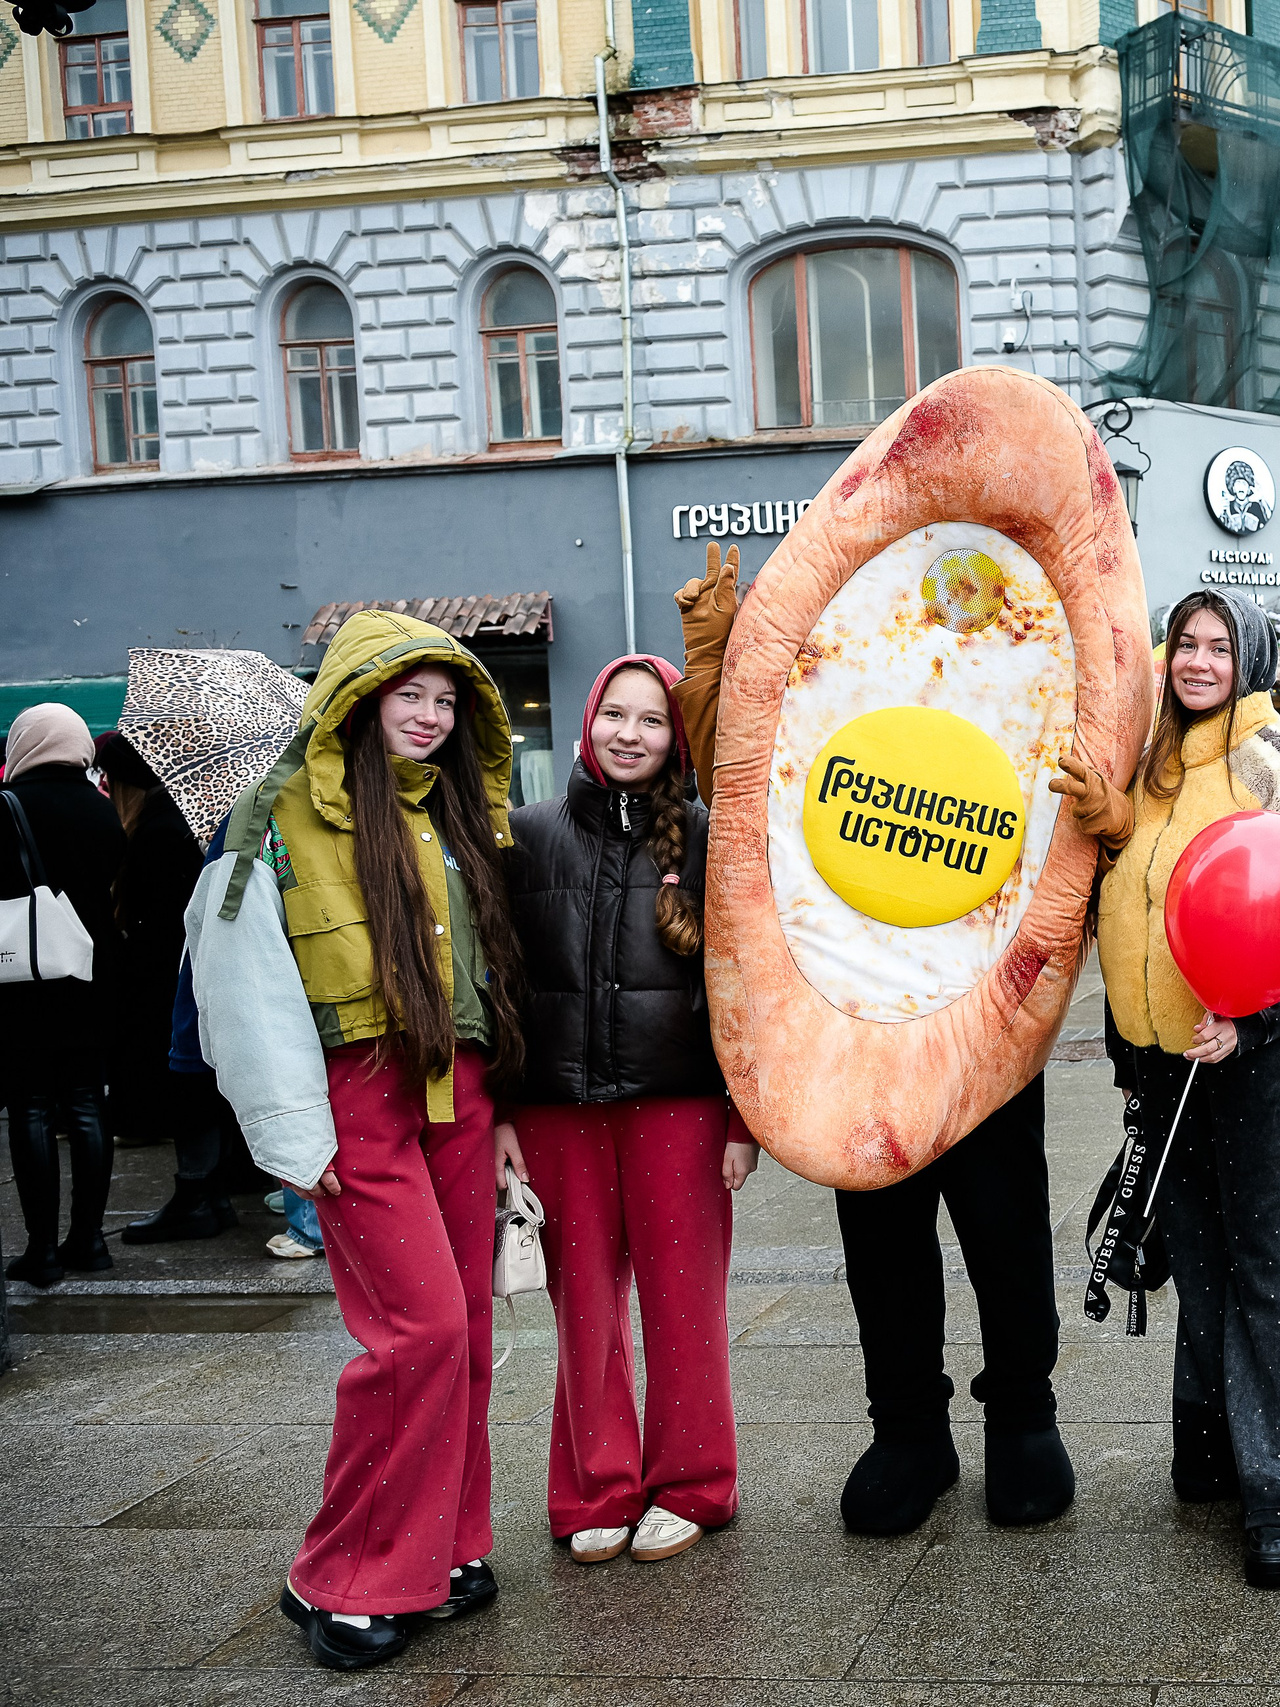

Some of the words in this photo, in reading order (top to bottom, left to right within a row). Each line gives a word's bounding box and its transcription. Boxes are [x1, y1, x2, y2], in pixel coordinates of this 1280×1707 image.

[1211, 549, 1273, 564] РЕСТОРАН
[1121, 1145, 1146, 1198] GUESS
[1093, 1227, 1120, 1283] GUESS
[1130, 1304, 1138, 1332] ANGELES
